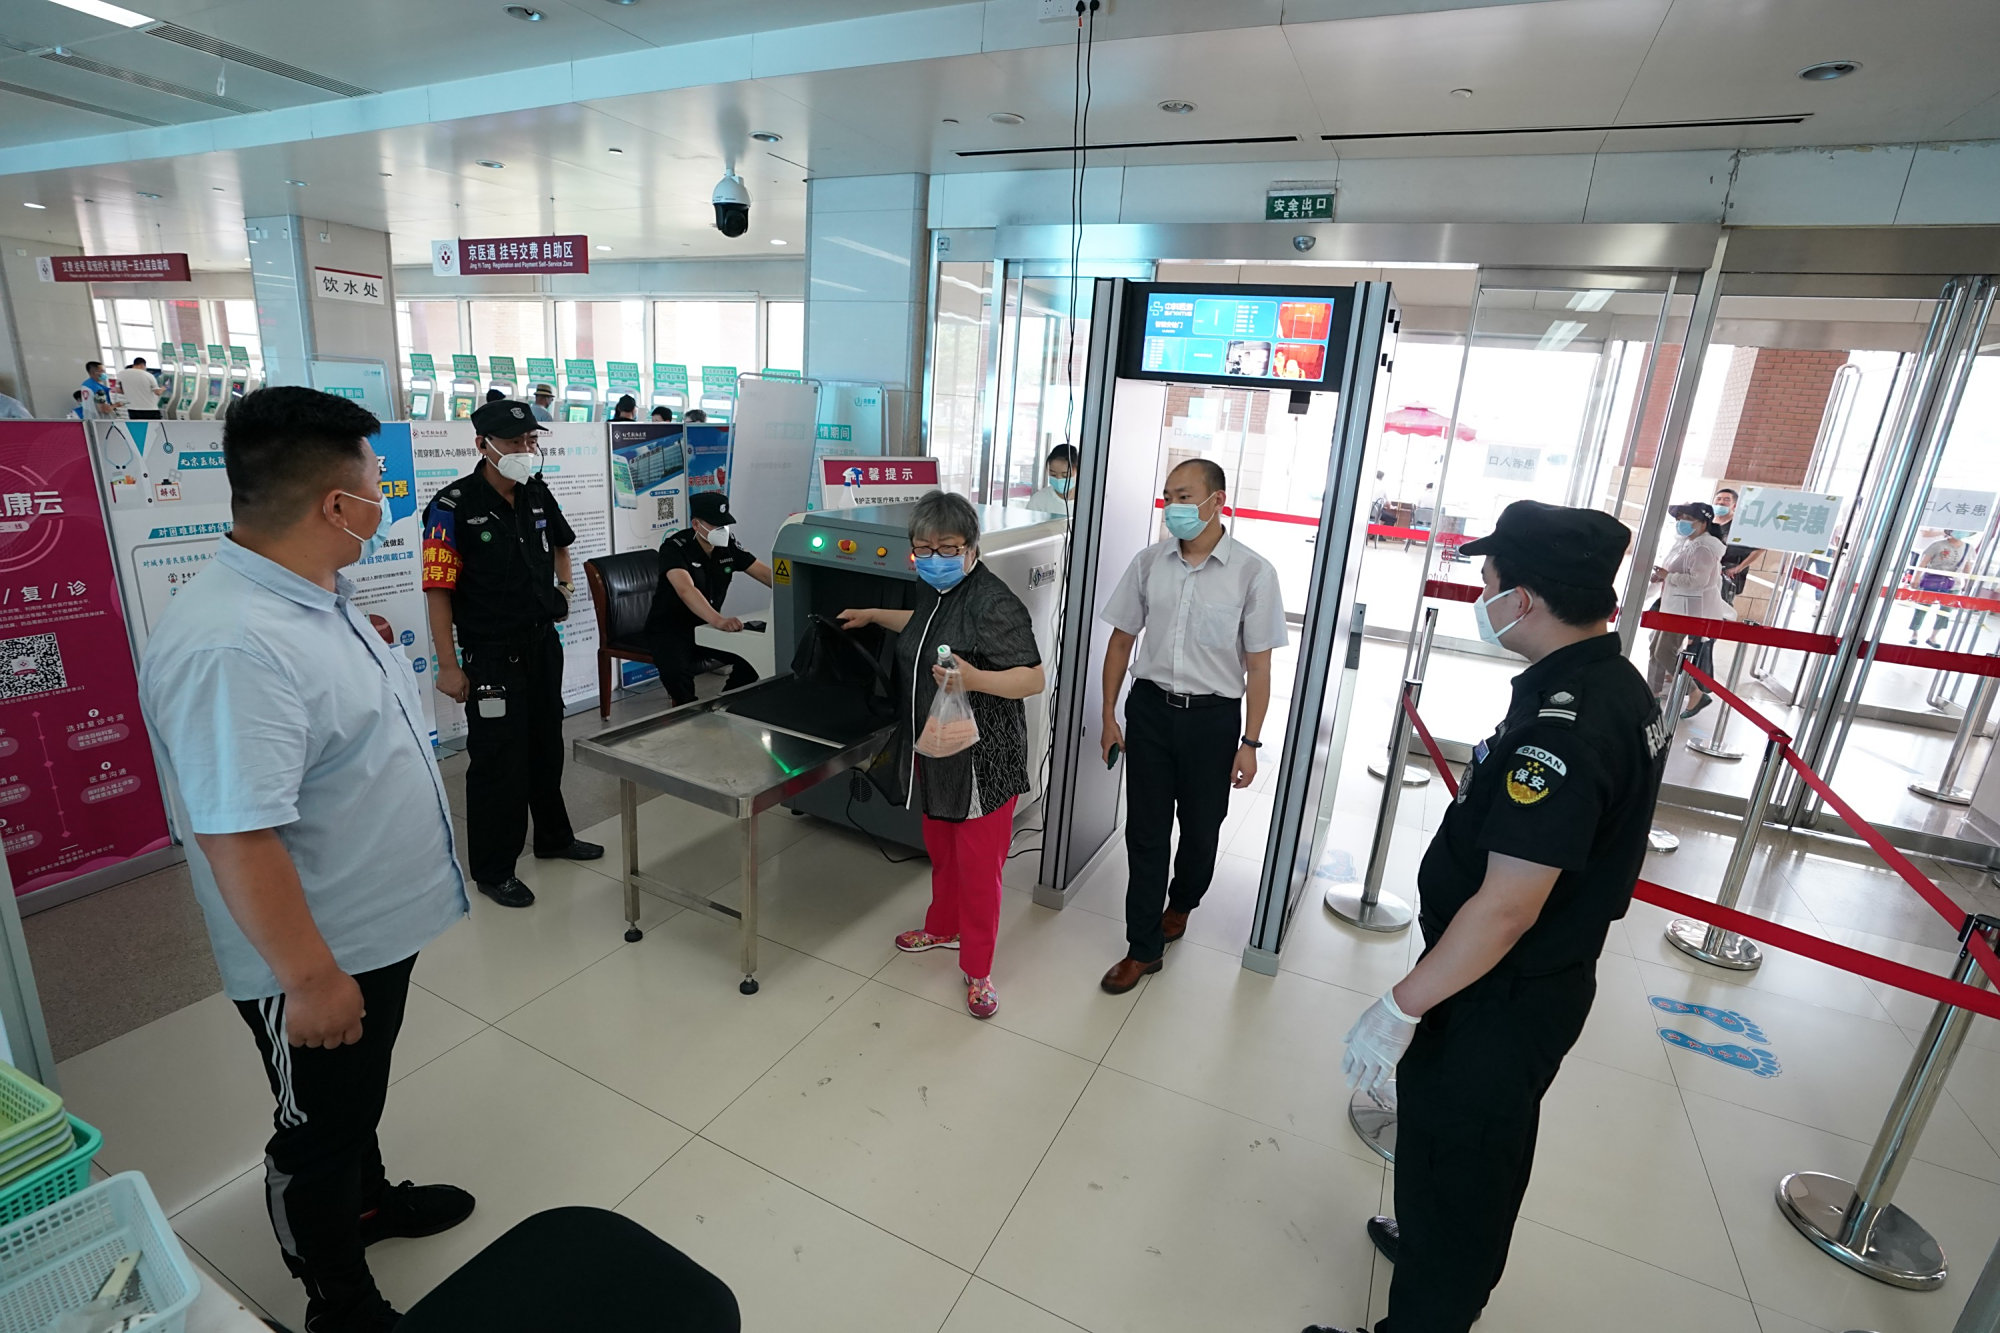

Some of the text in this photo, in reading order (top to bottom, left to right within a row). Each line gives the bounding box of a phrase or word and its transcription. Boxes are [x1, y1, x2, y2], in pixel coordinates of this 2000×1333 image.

[1274, 197, 1326, 212] 安全出口
[1283, 210, 1314, 218] EXIT
[468, 241, 574, 261] 京医通 挂号交费 自助区
[323, 276, 378, 298] 饮水处
[816, 426, 850, 440] 情期间
[379, 480, 409, 498] 口罩
[0, 490, 64, 517] 康云
[380, 538, 405, 549] 我做起
[1522, 747, 1562, 770] BAOAN
[1514, 768, 1545, 790] 保安
